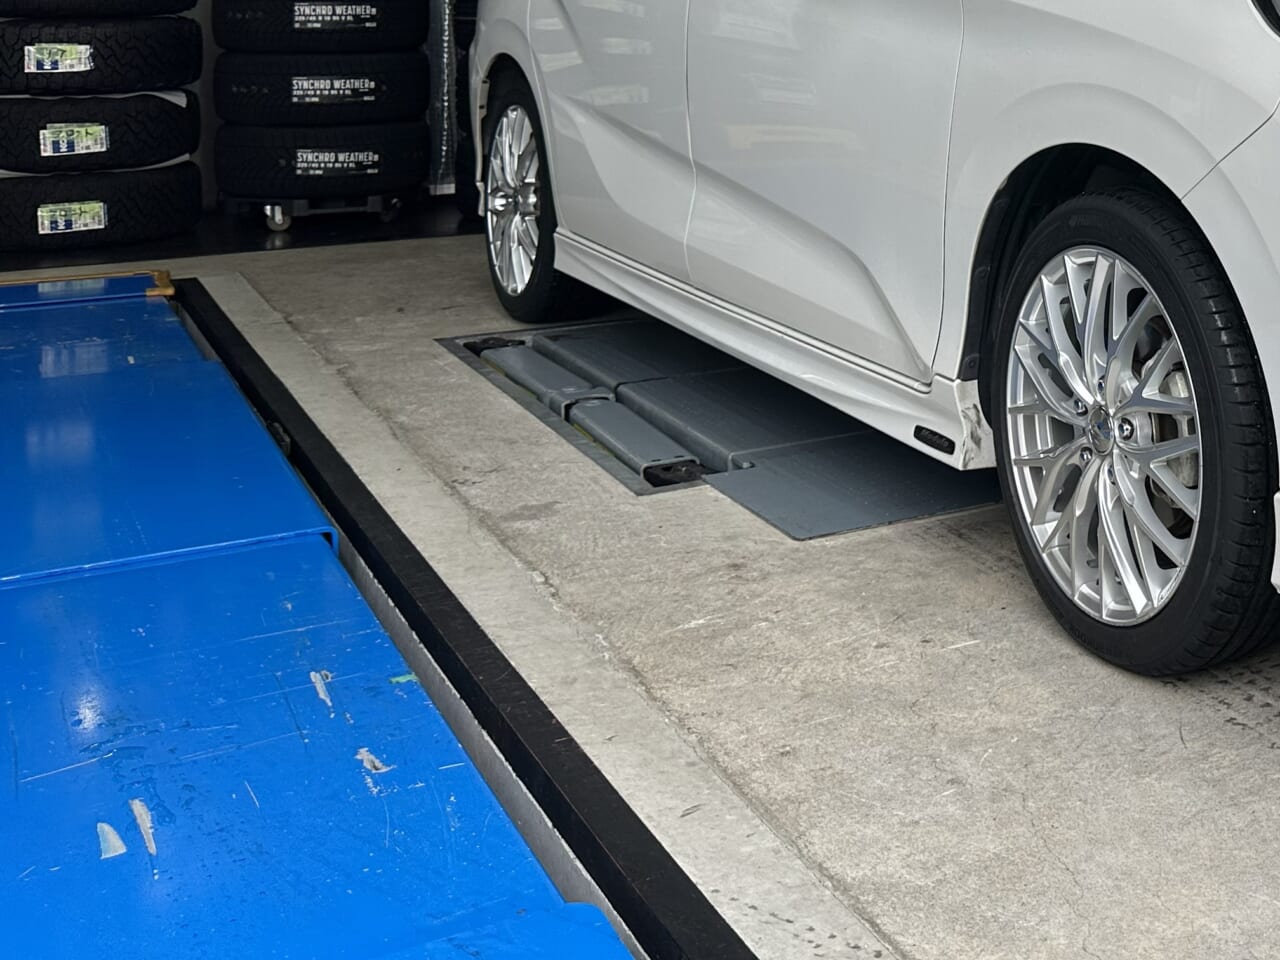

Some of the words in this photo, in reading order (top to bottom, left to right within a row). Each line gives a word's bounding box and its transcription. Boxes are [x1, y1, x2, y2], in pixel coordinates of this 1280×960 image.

[294, 5, 333, 16] SYNCHRO
[335, 4, 371, 15] WEATHER
[292, 79, 331, 90] SYNCHRO
[333, 79, 369, 89] WEATHER
[297, 152, 336, 162] SYNCHRO
[337, 151, 374, 162] WEATHER
